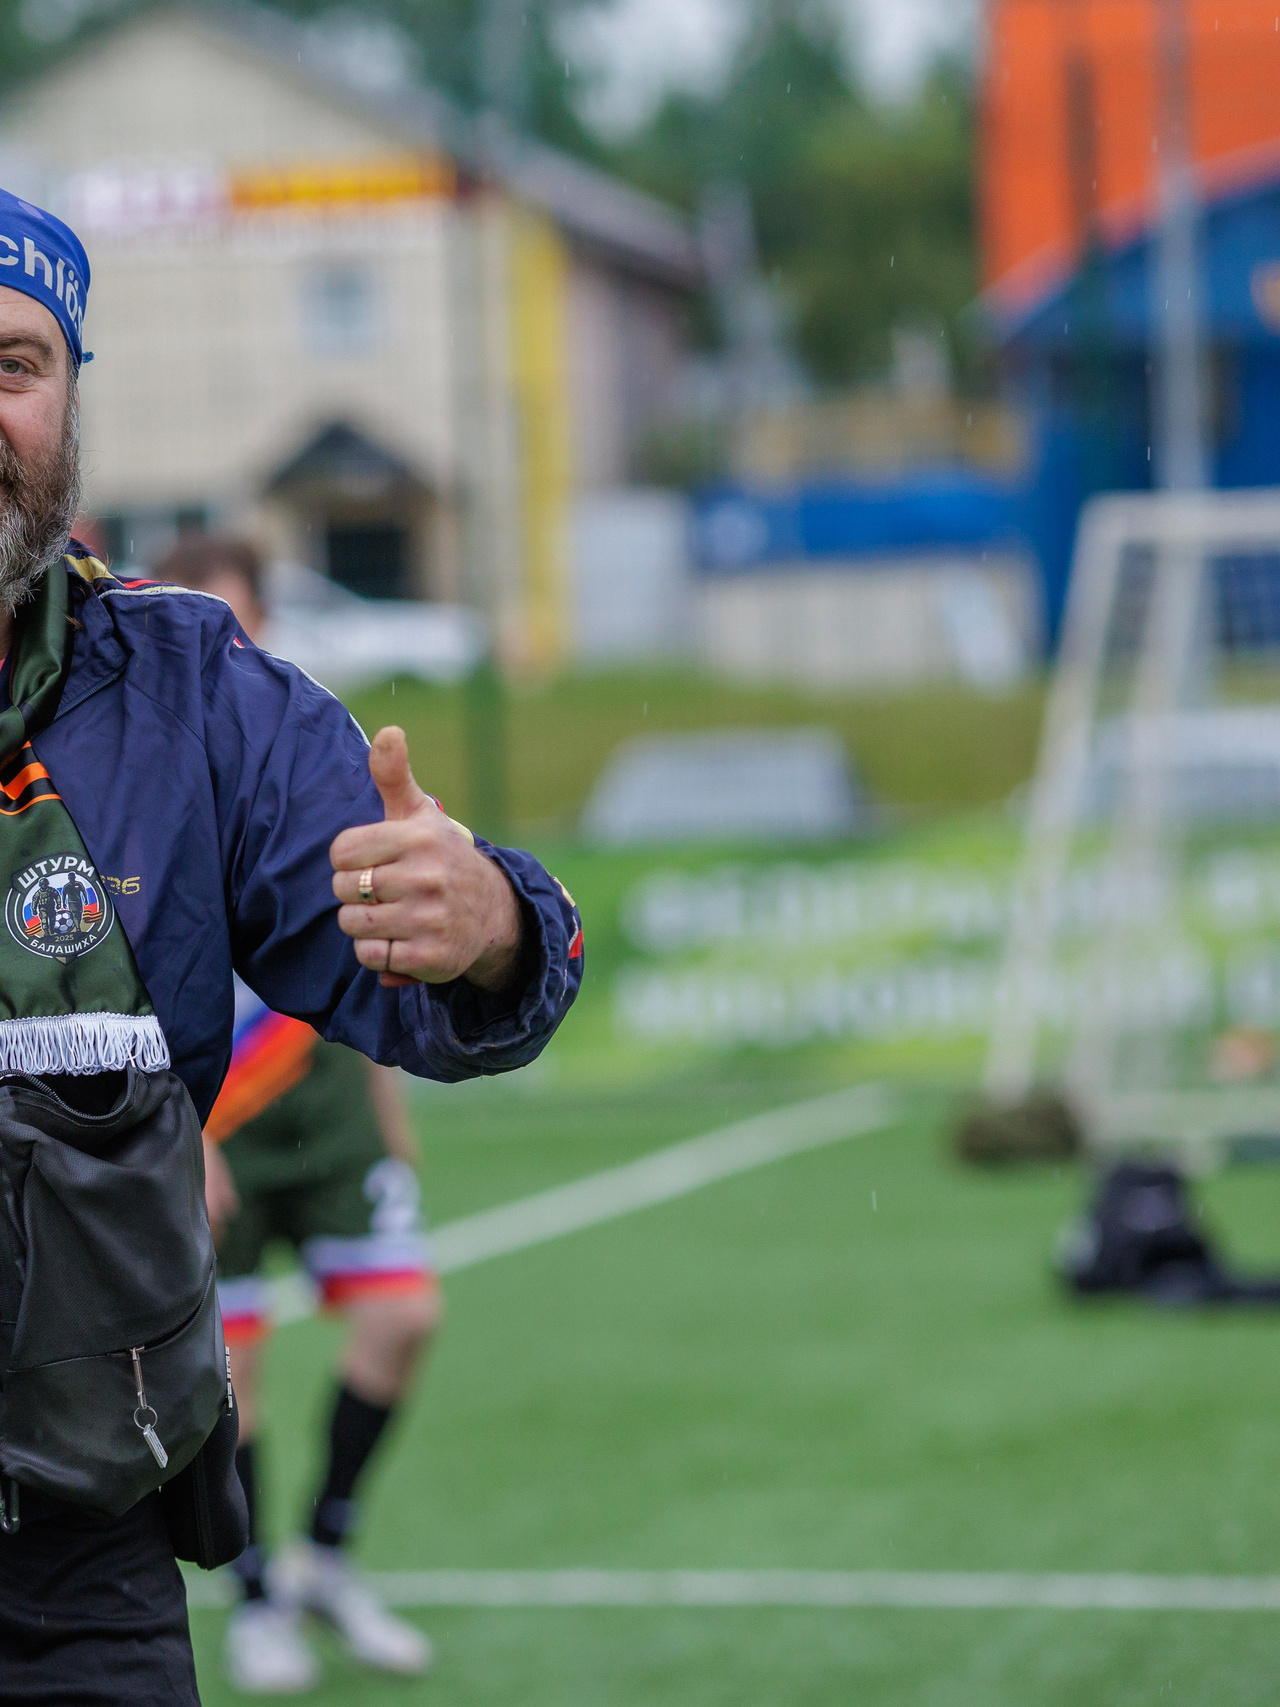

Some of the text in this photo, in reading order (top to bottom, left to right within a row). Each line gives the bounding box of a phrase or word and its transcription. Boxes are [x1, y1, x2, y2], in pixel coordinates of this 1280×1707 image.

[17, 856, 95, 889] ШТУРМ
[30, 934, 97, 954] БАЛАШИХА
[55, 934, 74, 943] 2025
